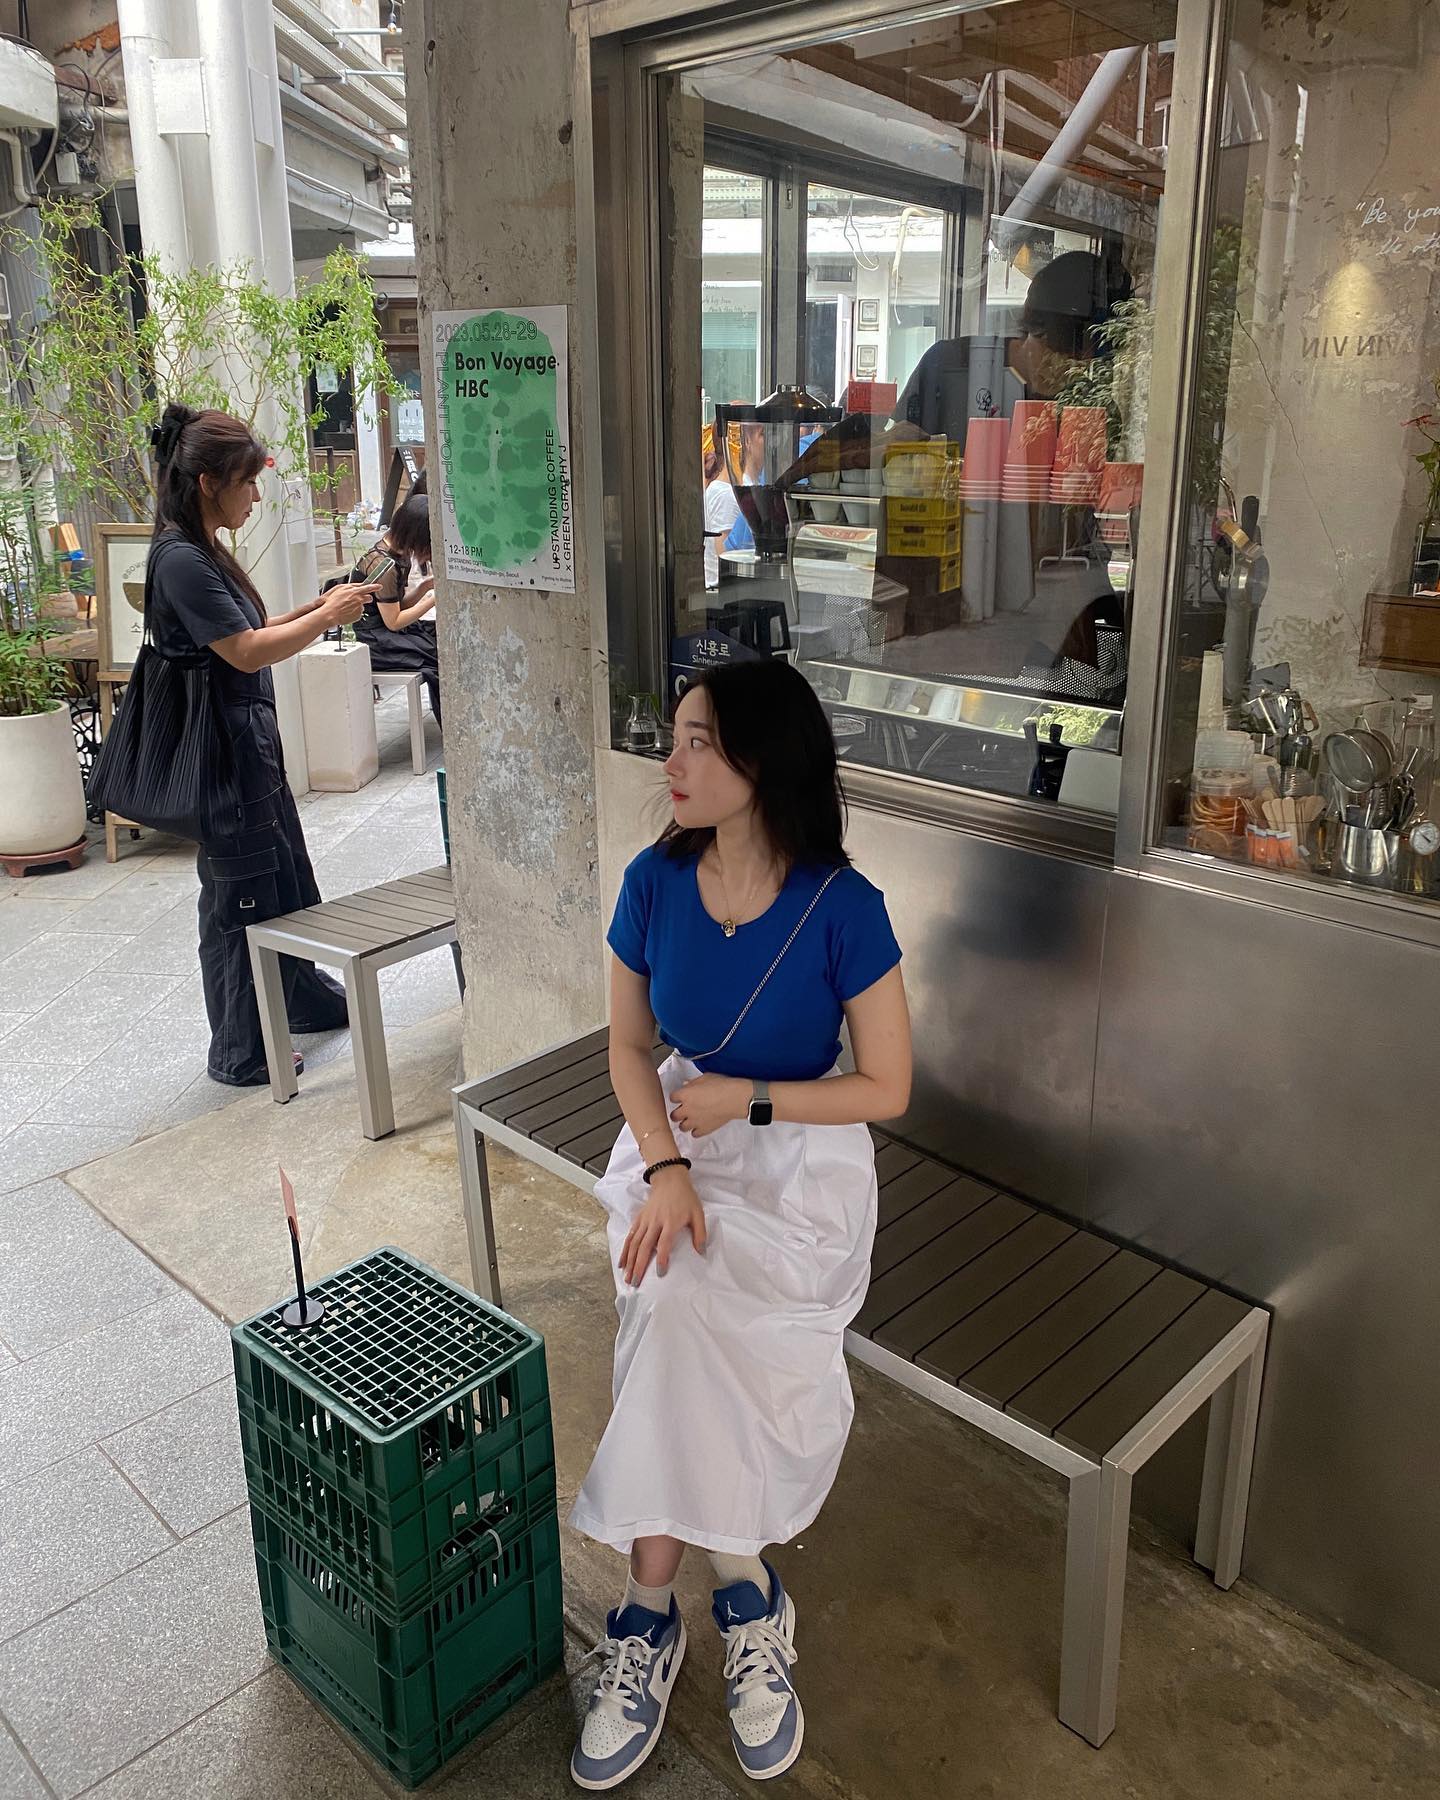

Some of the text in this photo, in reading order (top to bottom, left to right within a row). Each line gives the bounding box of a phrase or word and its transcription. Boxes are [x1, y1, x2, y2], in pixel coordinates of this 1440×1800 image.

[435, 320, 538, 342] 2023.05.28-29
[455, 352, 486, 371] Bon
[455, 379, 489, 398] HBC
[436, 351, 456, 514] PLANT POP-UP
[558, 455, 570, 512] GRAPHY
[545, 429, 561, 570] UPSTANDING COFFEE
[562, 516, 571, 561] GREEN
[449, 544, 483, 557] 12-18 PM
[696, 639, 731, 657] 신흥로
